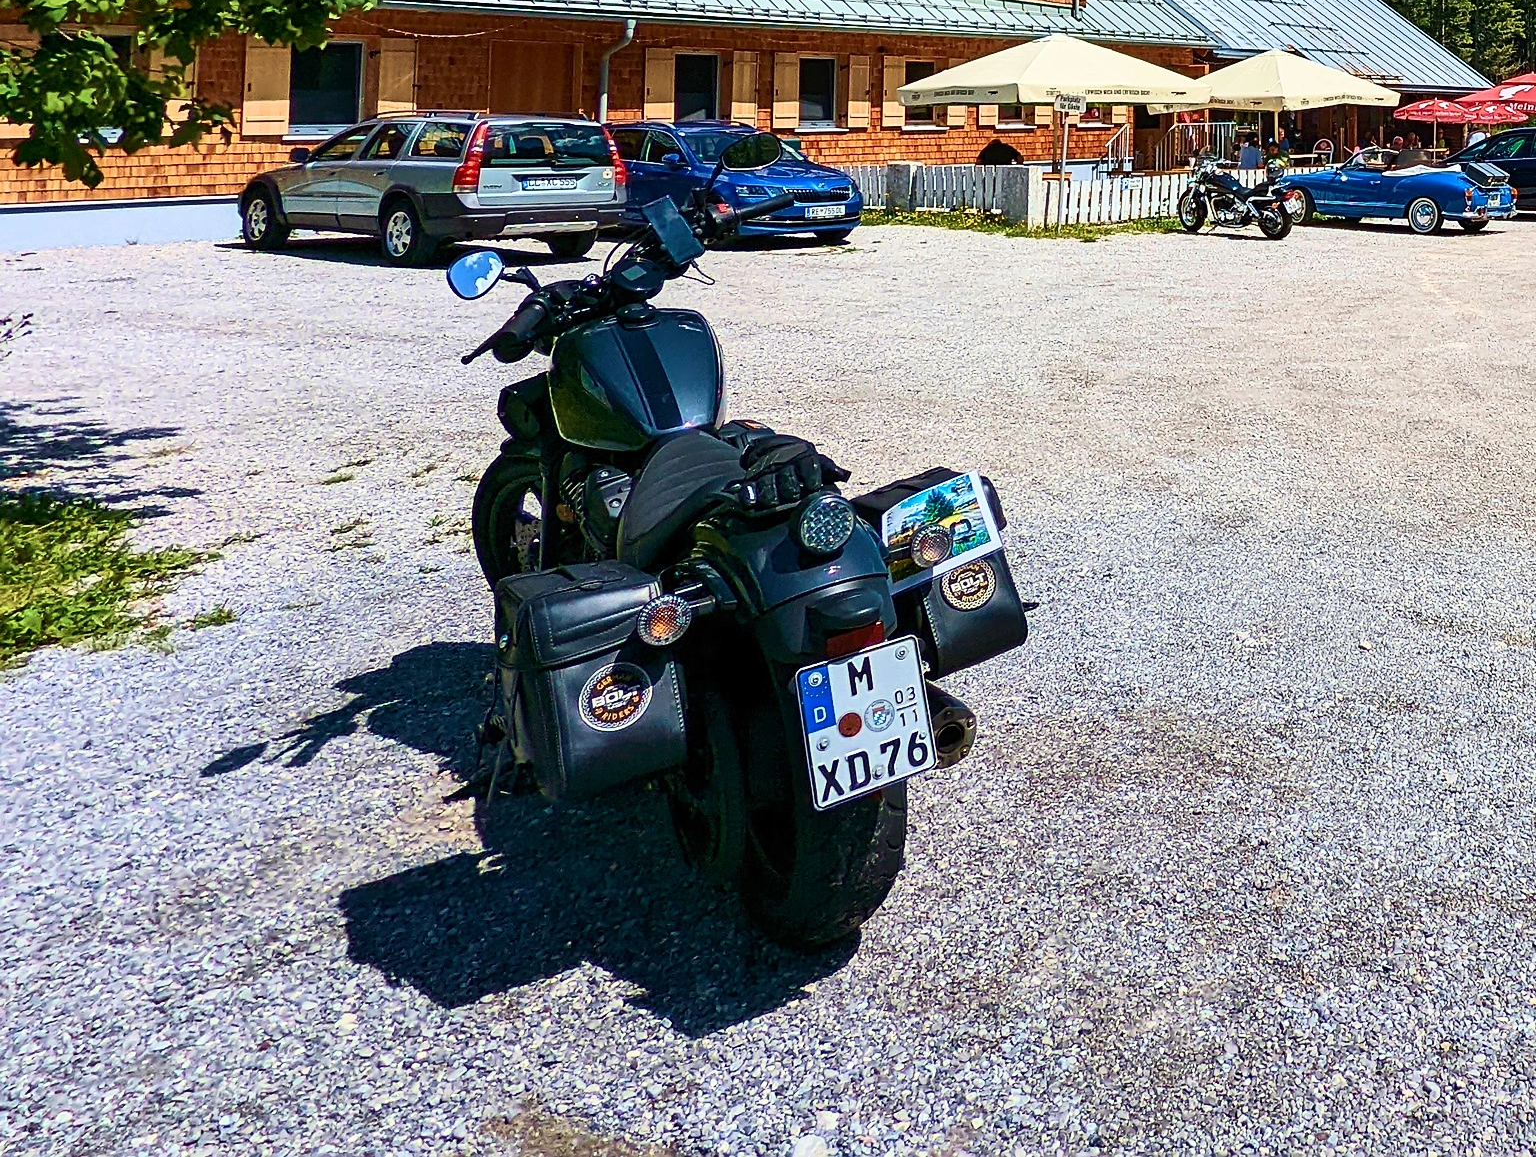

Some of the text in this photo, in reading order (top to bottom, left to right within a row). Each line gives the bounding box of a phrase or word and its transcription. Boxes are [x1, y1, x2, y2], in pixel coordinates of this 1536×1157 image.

[950, 573, 986, 593] BOLT
[847, 656, 874, 696] M
[894, 686, 916, 704] 03
[601, 705, 634, 721] RIDERS
[814, 706, 827, 724] D
[899, 708, 919, 727] 11
